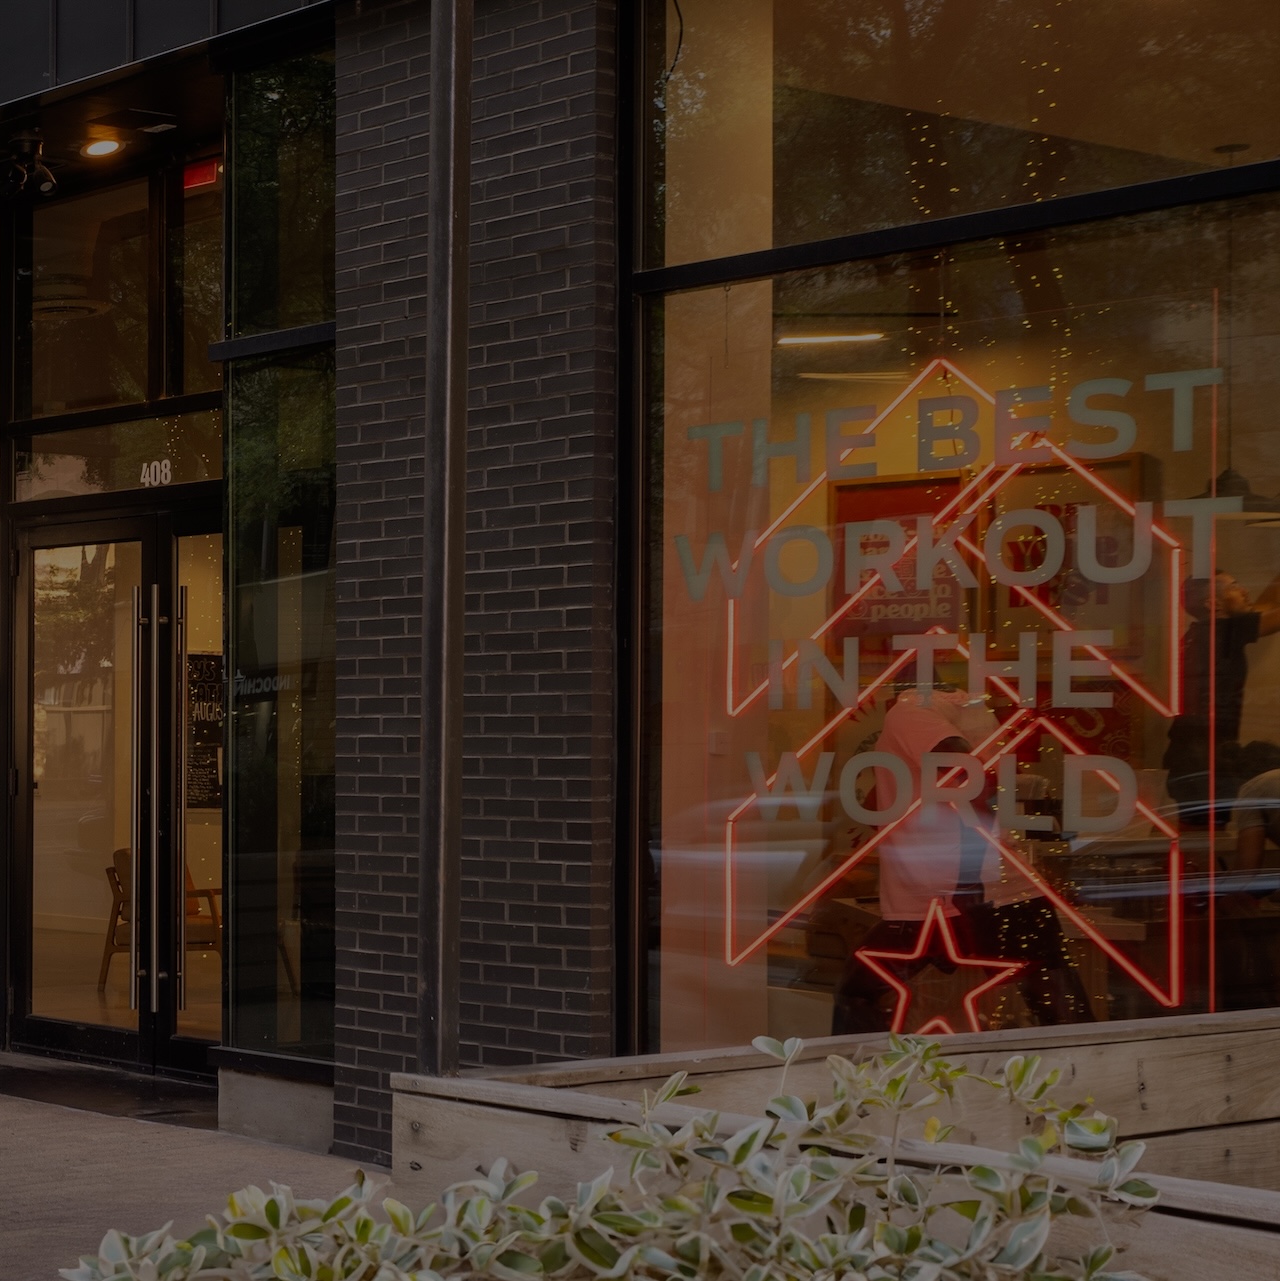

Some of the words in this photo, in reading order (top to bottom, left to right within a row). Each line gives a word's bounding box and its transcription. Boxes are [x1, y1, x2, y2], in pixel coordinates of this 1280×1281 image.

[686, 404, 880, 493] THE
[917, 368, 1224, 472] BEST
[140, 459, 172, 488] 408
[673, 496, 1243, 604] WORKOUT
[869, 599, 952, 622] people
[767, 636, 860, 711] IN
[892, 629, 1114, 709] THE
[744, 751, 1140, 834] WORLD
